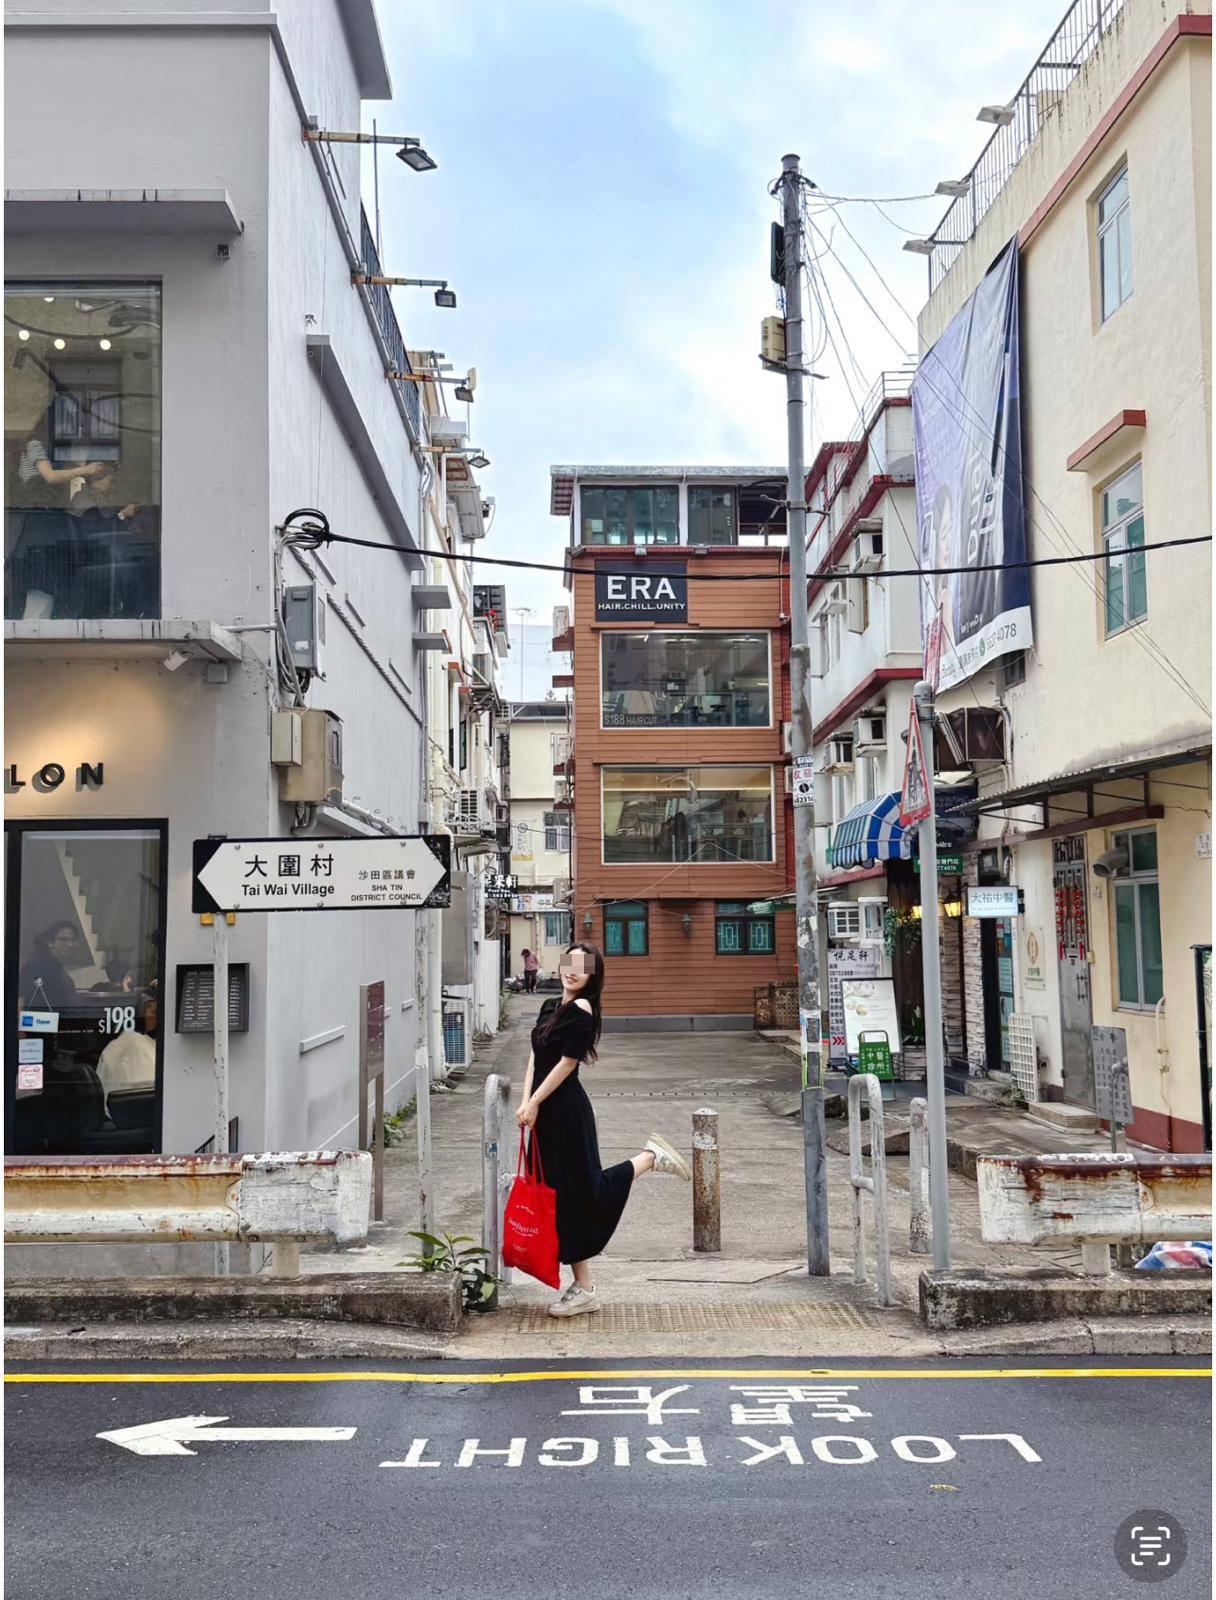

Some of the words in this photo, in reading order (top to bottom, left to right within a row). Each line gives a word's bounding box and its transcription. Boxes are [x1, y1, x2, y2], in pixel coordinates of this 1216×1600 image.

[607, 576, 676, 600] ERA
[604, 714, 625, 725] $188
[626, 716, 657, 725] HAIRCUT
[244, 853, 335, 878] 大圍村
[358, 869, 417, 881] 沙田區議會
[241, 884, 260, 896] Tai
[263, 883, 288, 896] Wai
[292, 883, 335, 897] Village
[351, 893, 386, 902] DISTRICT
[388, 893, 423, 901] COUNCIL
[371, 884, 387, 892] SHA
[390, 884, 403, 892] TIN
[98, 1006, 136, 1034] $198
[561, 1385, 872, 1426] 望右
[378, 1435, 709, 1468] RIGHT
[742, 1434, 1042, 1465] LOOK
